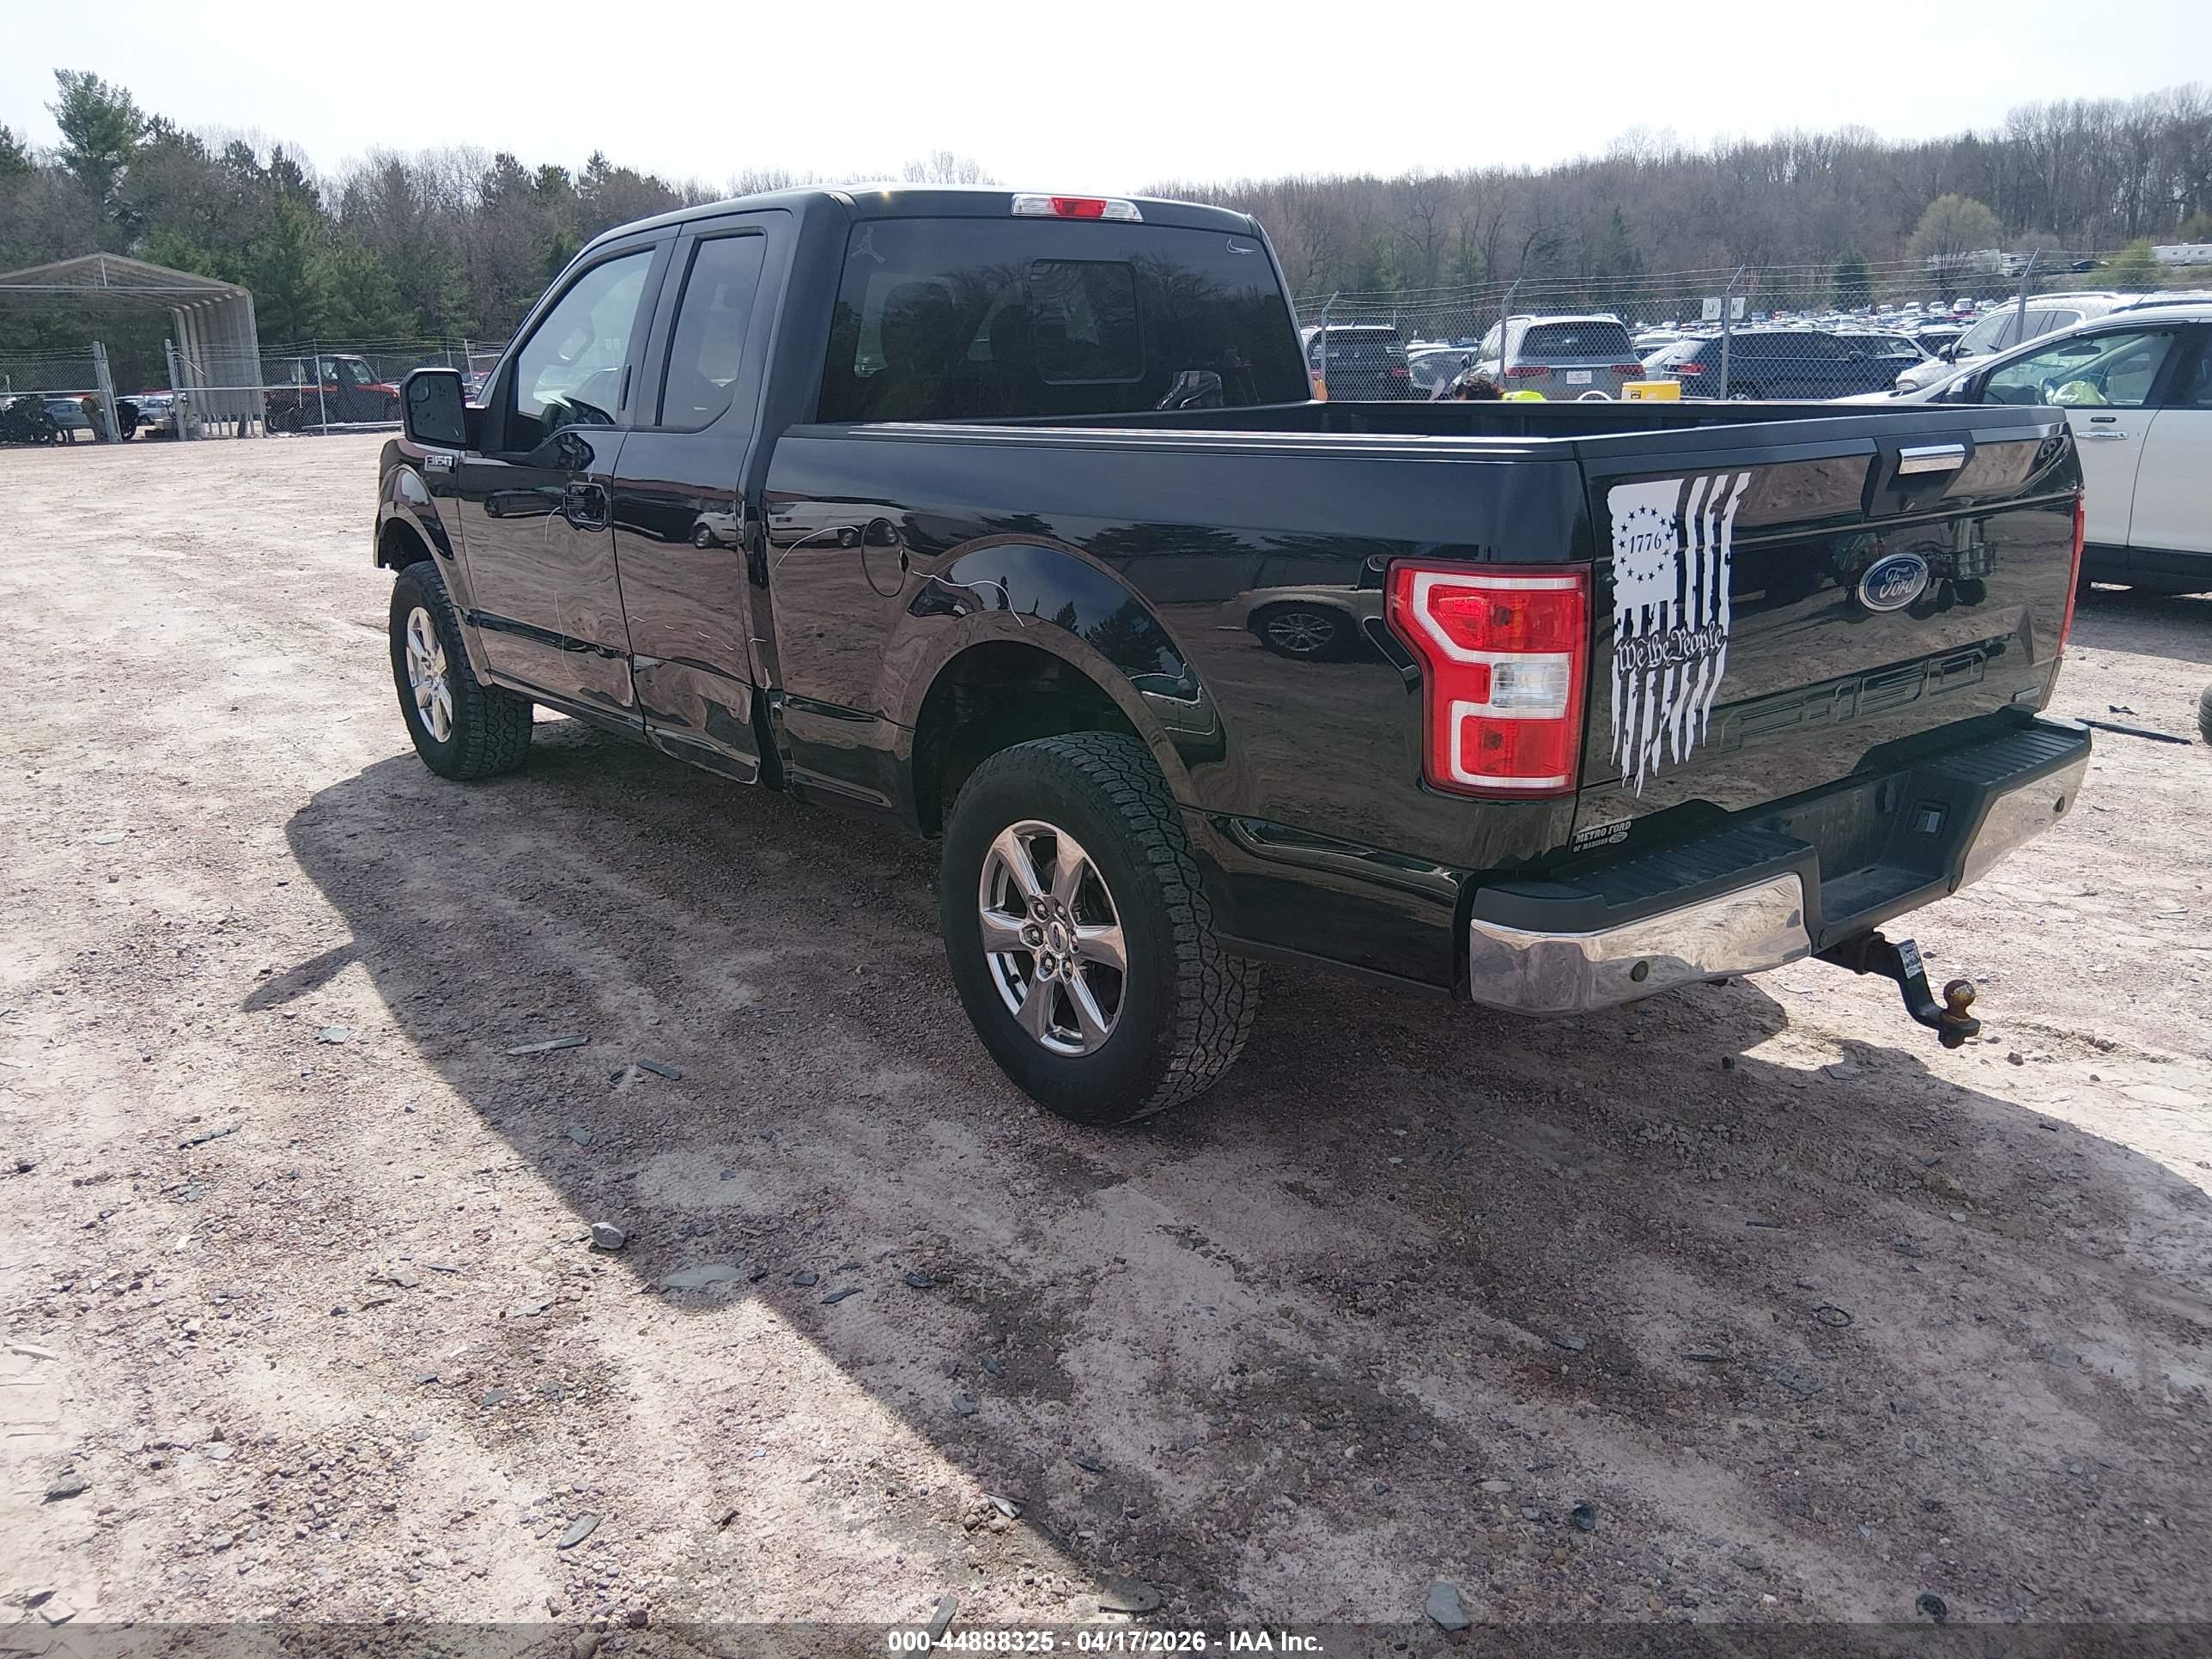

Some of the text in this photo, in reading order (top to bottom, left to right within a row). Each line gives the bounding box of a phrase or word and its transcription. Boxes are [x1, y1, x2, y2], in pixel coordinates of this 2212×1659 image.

[1708, 304, 1715, 313] J
[1731, 303, 1738, 313] K
[1629, 532, 1662, 554] 1776
[1879, 564, 1917, 599] Ford
[1615, 620, 1727, 676] We the People
[1575, 827, 1607, 843] METRO
[1607, 821, 1632, 835] FORD
[1573, 844, 1582, 853] OF
[1582, 837, 1608, 850] MADISON
